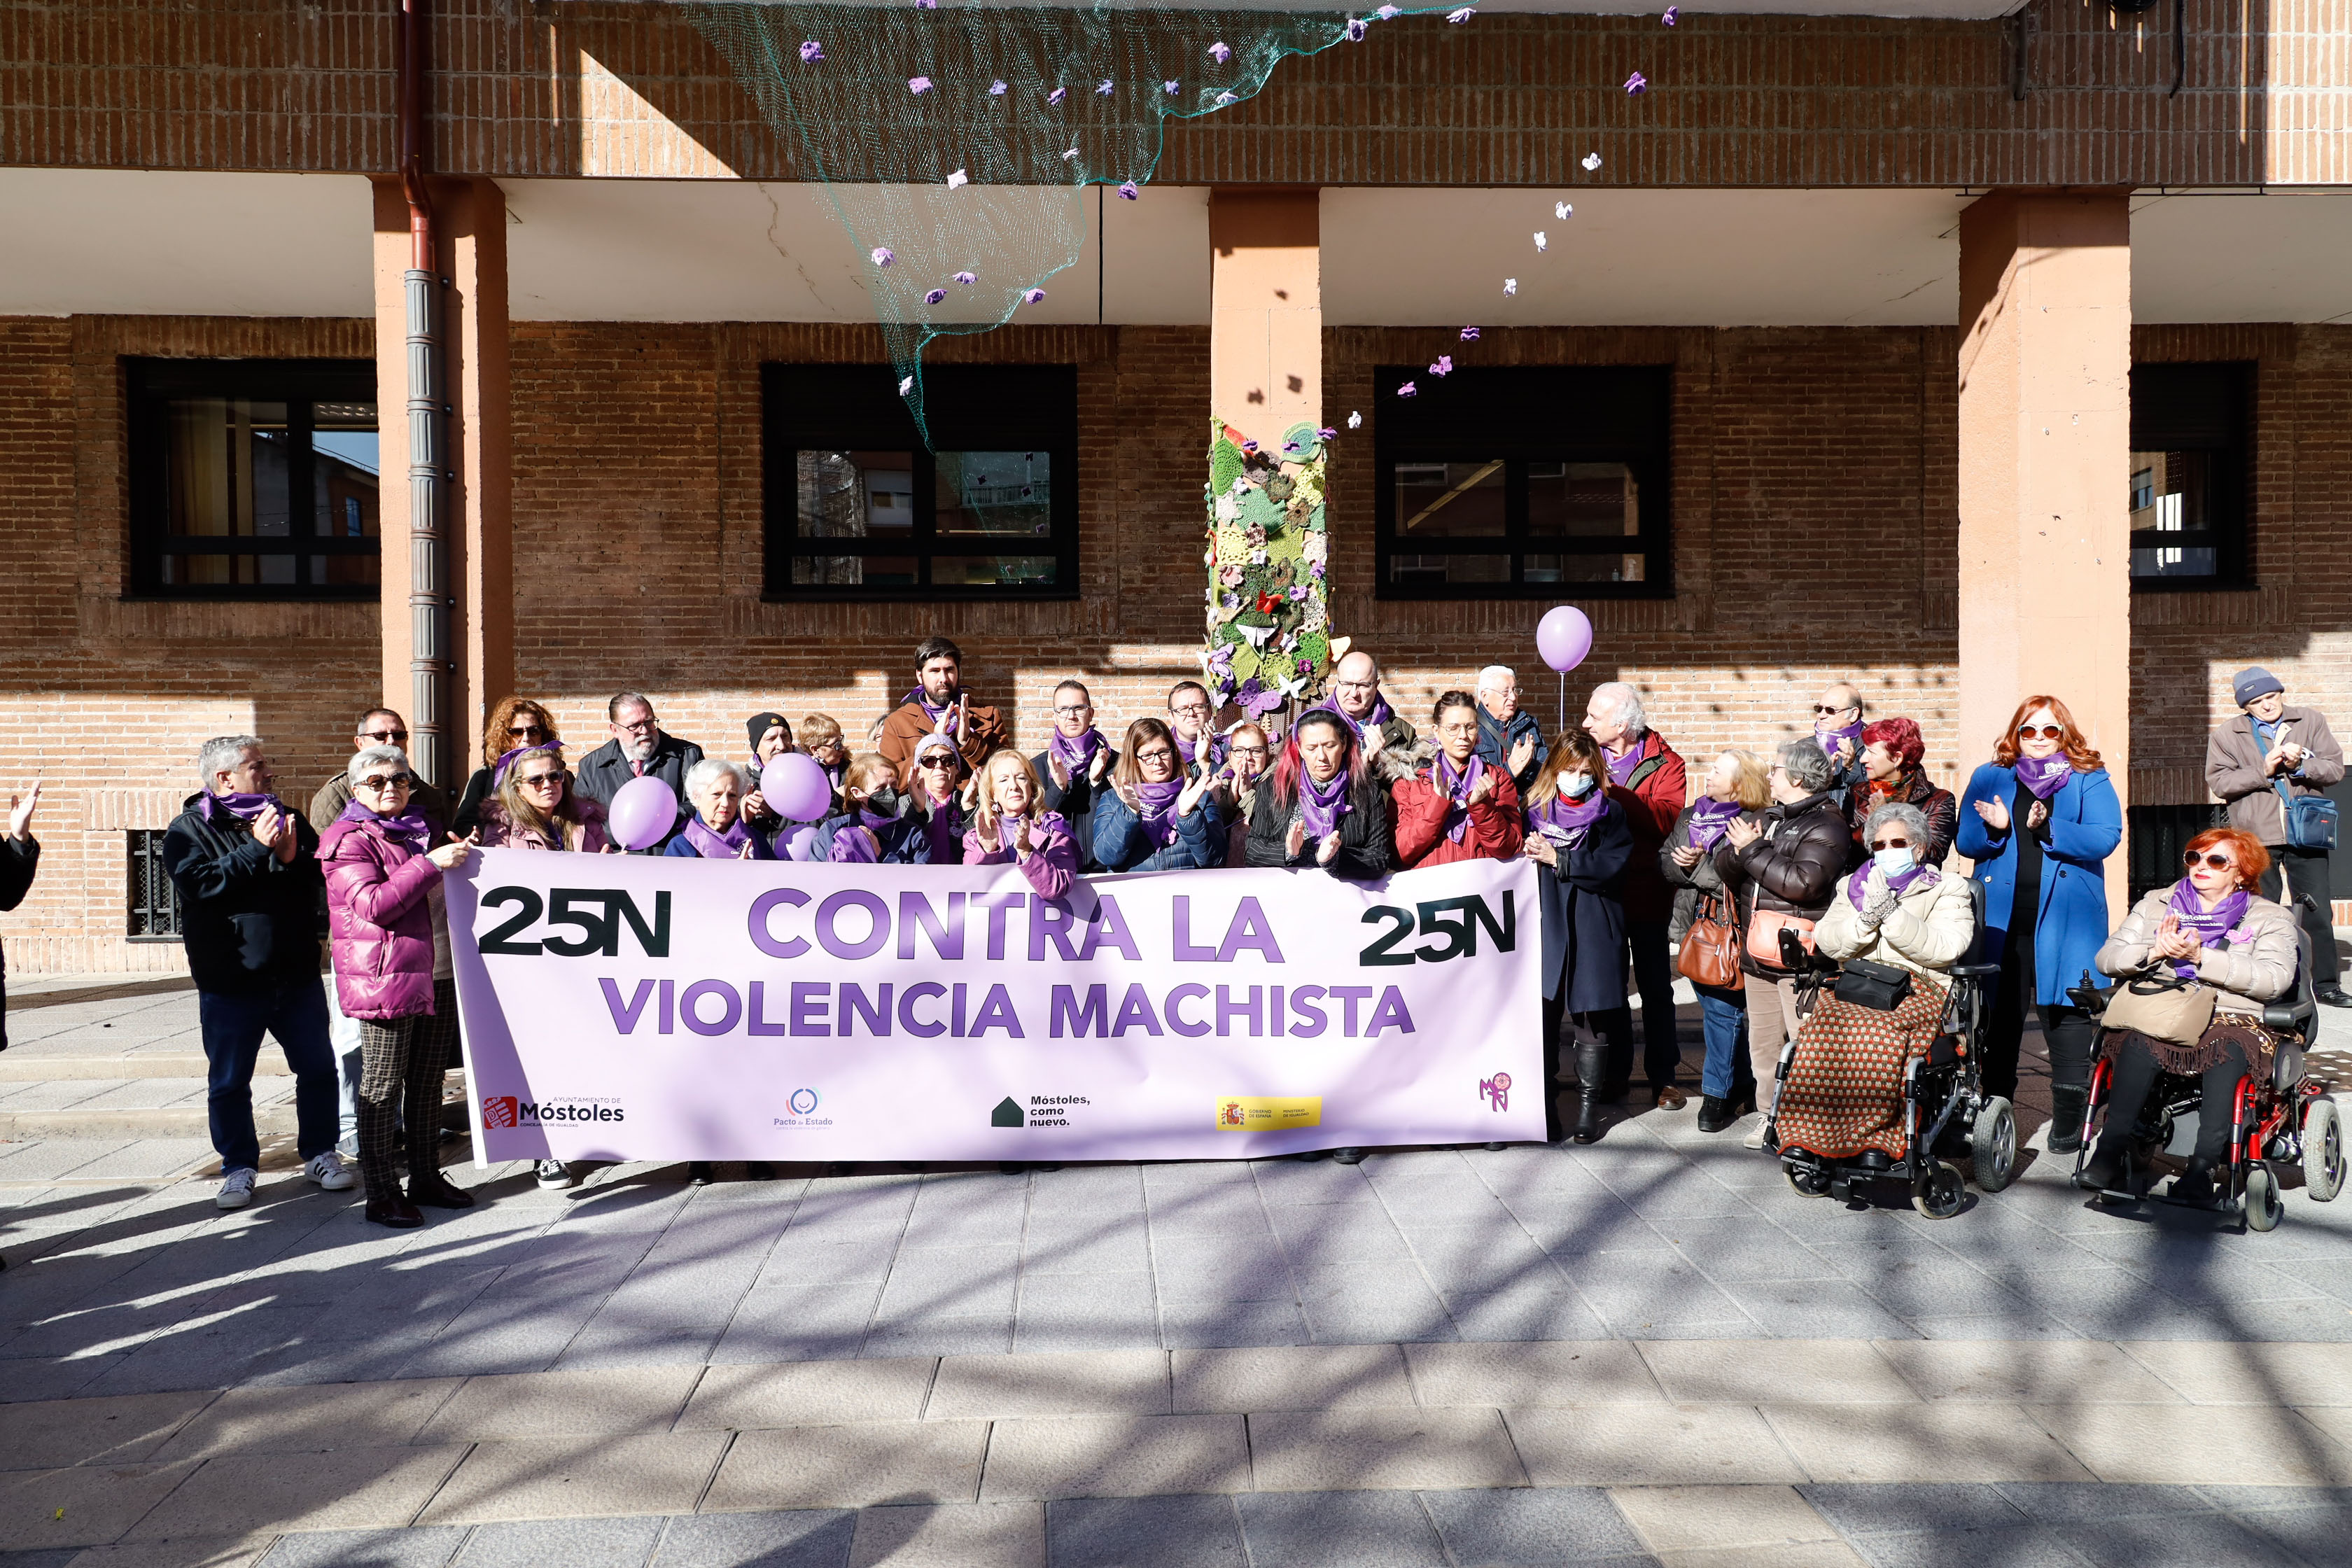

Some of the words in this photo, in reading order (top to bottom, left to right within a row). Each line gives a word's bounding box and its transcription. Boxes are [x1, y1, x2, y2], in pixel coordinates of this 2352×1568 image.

[478, 886, 671, 958] 25N
[748, 888, 1142, 962] CONTRA
[1172, 895, 1285, 963] LA
[1359, 889, 1516, 967] 25N
[598, 978, 1025, 1039] VIOLENCIA
[1049, 983, 1416, 1039] MACHISTA
[1030, 1095, 1091, 1105] Móstoles,
[520, 1102, 624, 1121] Móstoles
[1030, 1108, 1065, 1116] como
[805, 1117, 833, 1126] Estado
[1030, 1119, 1070, 1127] nuevo.
